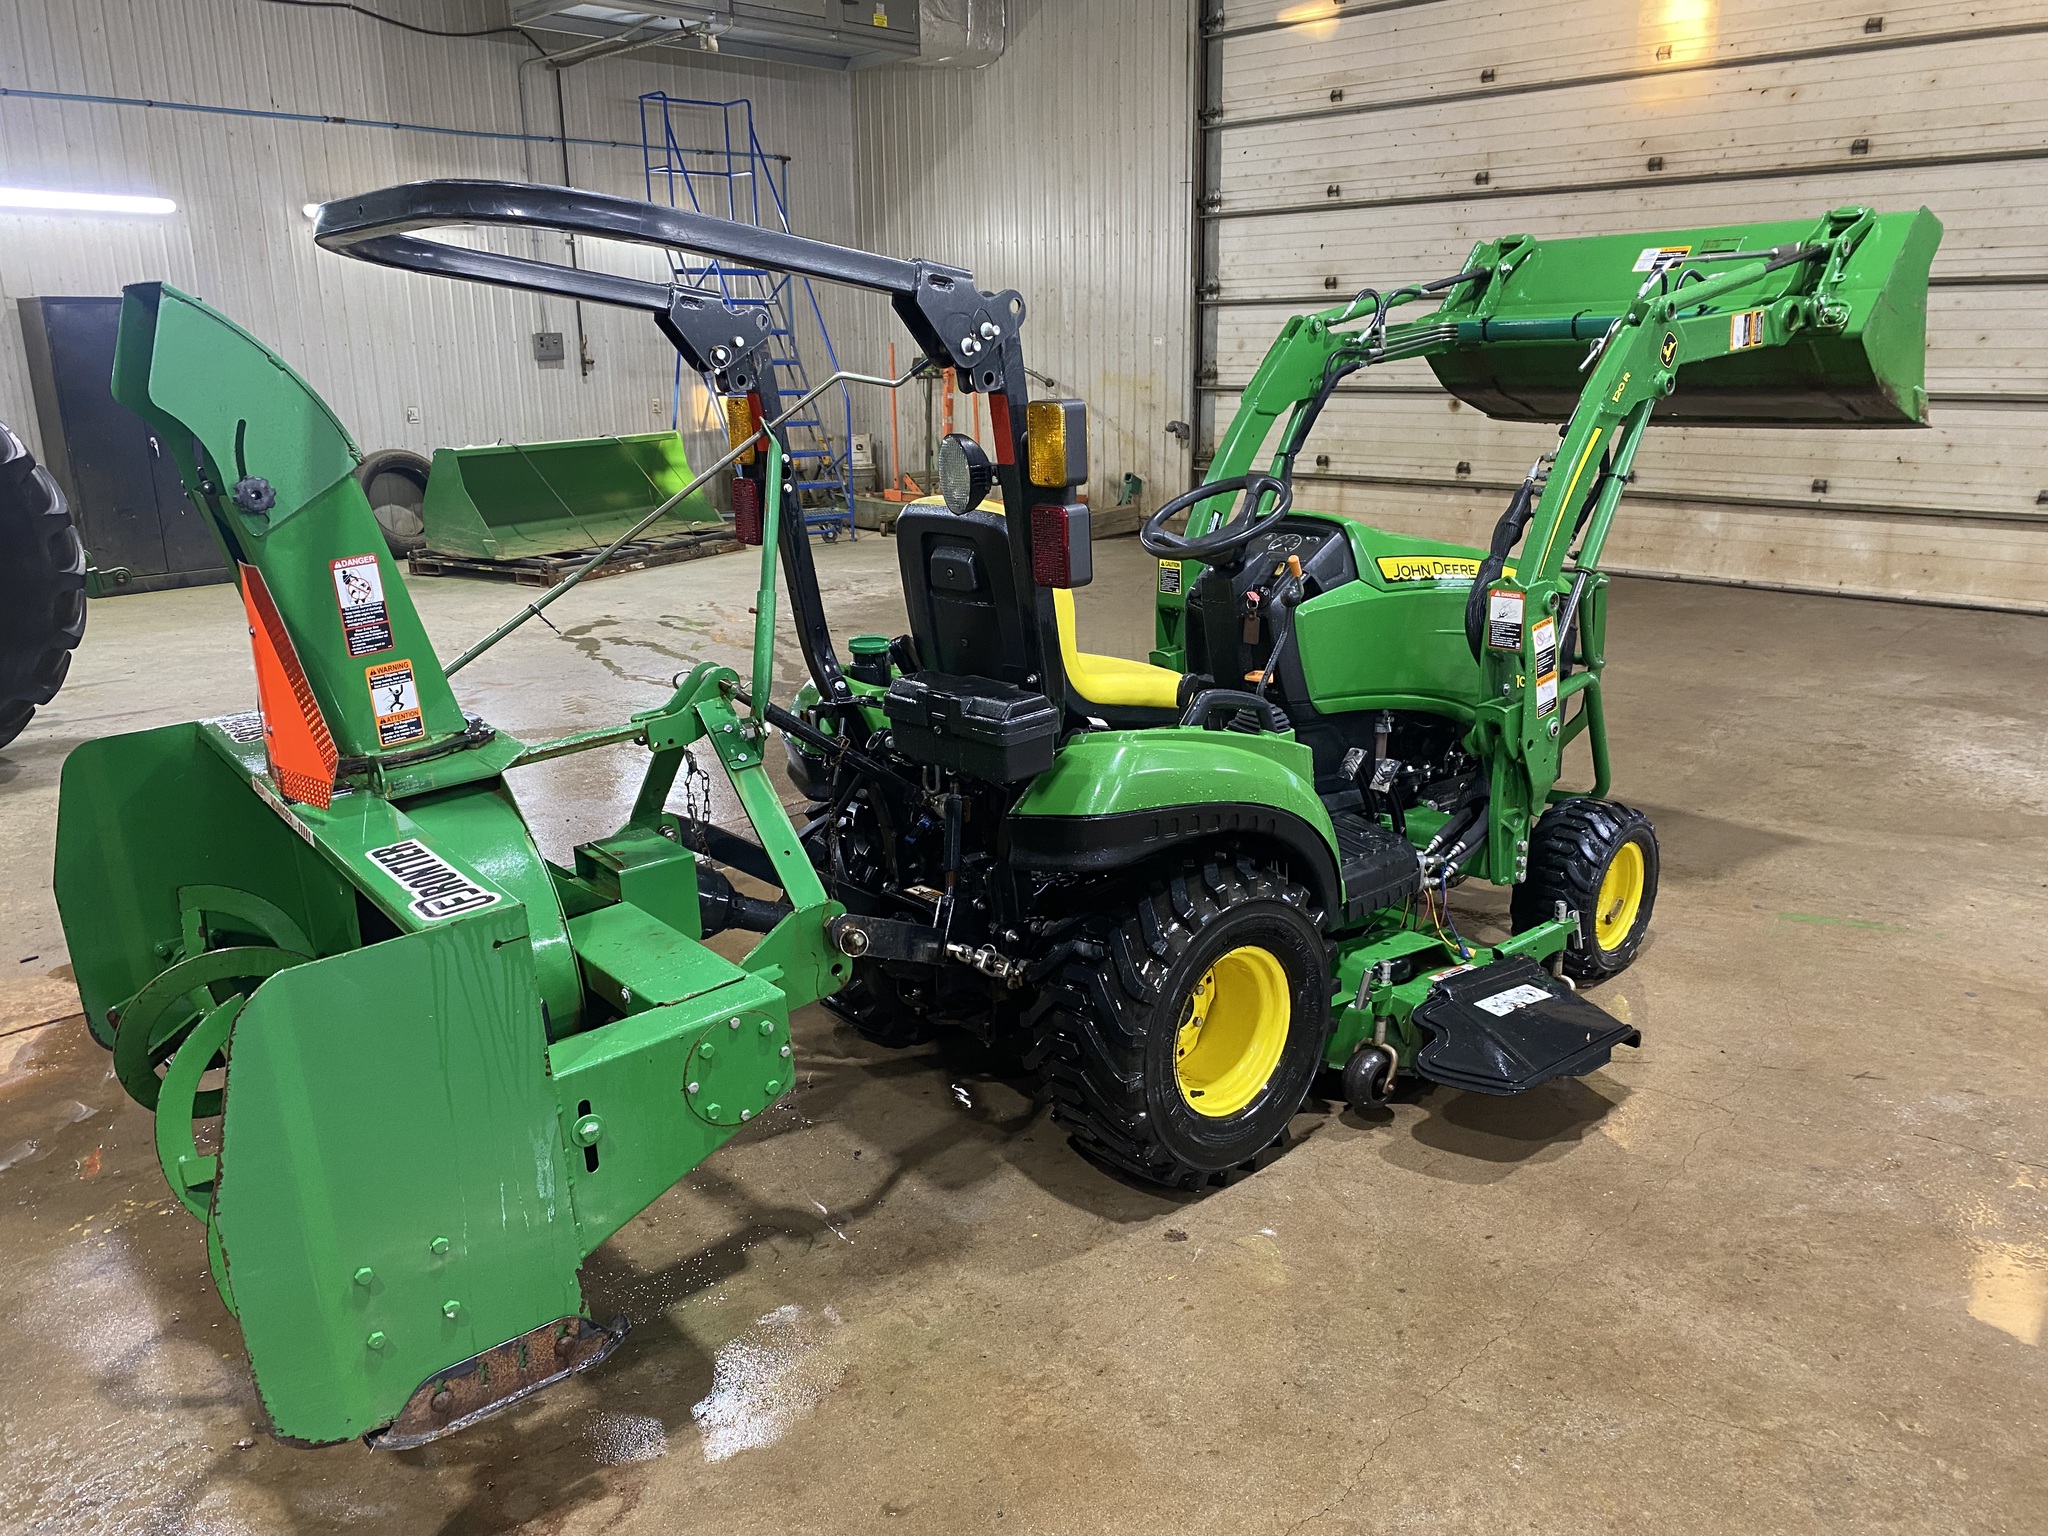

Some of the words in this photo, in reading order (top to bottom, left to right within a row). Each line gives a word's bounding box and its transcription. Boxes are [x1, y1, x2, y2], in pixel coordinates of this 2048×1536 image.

[341, 555, 375, 568] DANGER
[1393, 563, 1431, 578] JOHN
[1433, 561, 1476, 576] DEERE
[377, 662, 409, 674] WARNING
[387, 709, 419, 722] ATTENTION
[371, 841, 496, 918] FRONTIER
